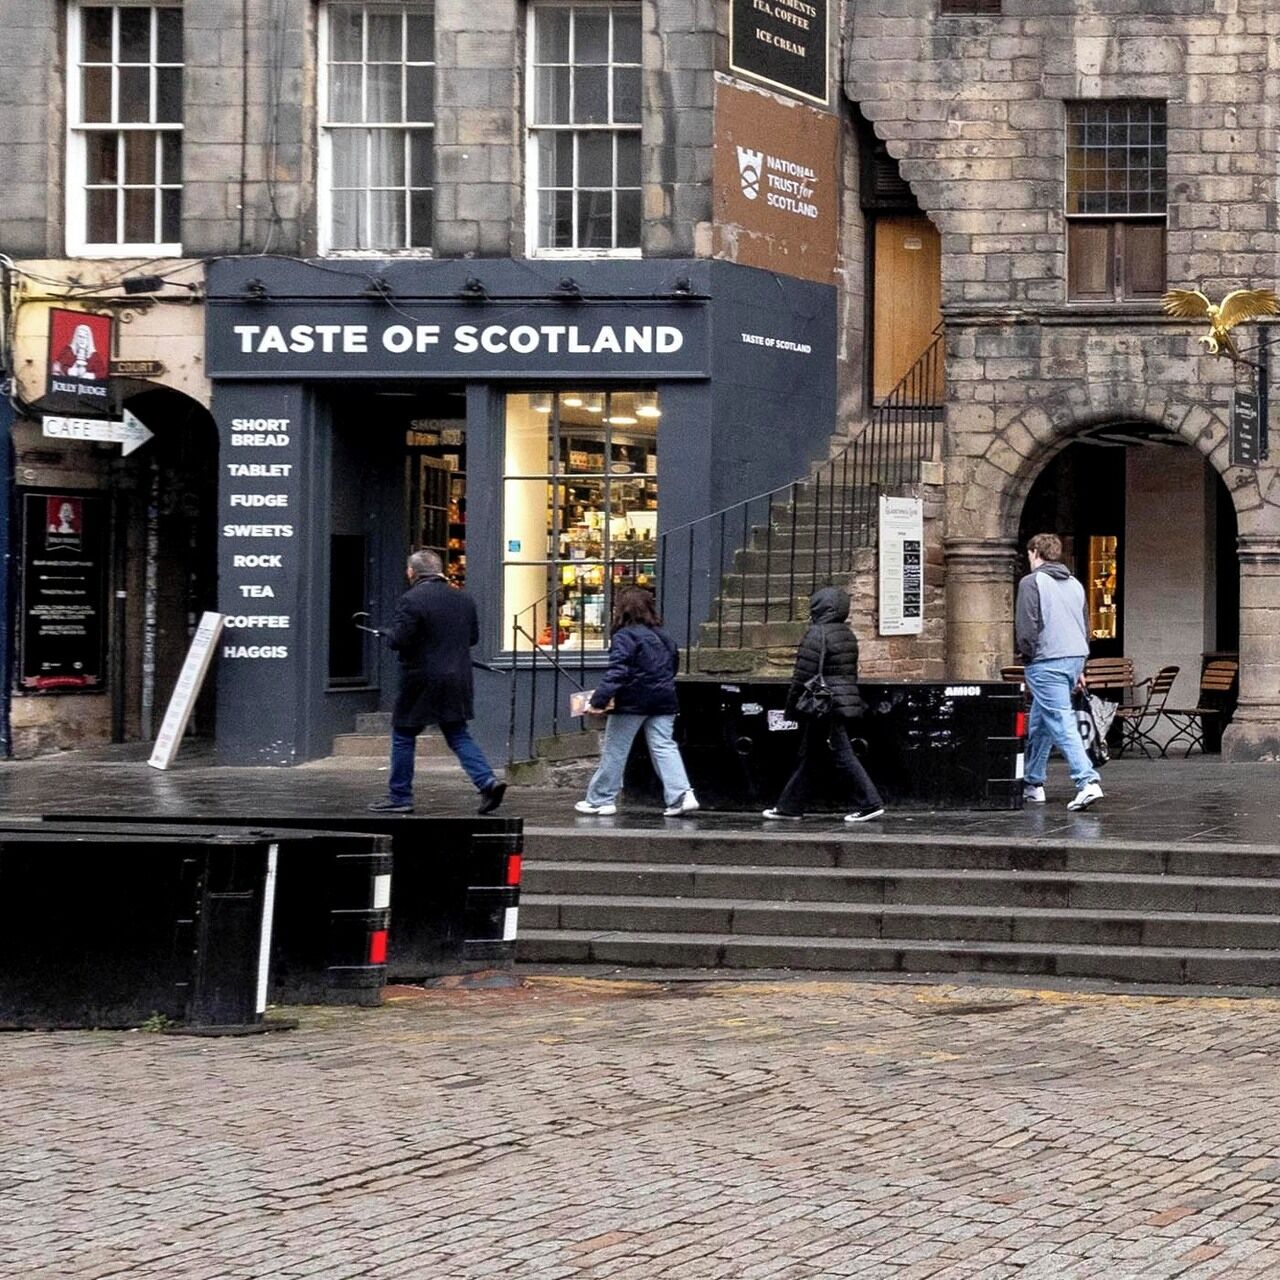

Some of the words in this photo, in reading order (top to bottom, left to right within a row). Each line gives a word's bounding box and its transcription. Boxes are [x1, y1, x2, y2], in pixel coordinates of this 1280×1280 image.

[774, 6, 810, 31] COFFEE
[756, 28, 772, 43] ICE
[773, 35, 806, 58] CREAM
[767, 156, 817, 181] NATIONAL
[767, 174, 799, 194] TRUST
[796, 182, 814, 200] for
[767, 193, 818, 218] SCOTLAND
[233, 325, 368, 354] TASTE
[381, 325, 440, 354] OF
[453, 325, 684, 354] SCOTLAND
[741, 333, 764, 346] TASTE
[764, 337, 775, 347] OF
[776, 339, 812, 353] SCOTLAND
[118, 361, 154, 372] COURT
[52, 380, 77, 394] JOLLY
[77, 382, 107, 397] JUDGE
[45, 419, 91, 437] CAFE
[231, 419, 290, 432] SHORT
[231, 433, 290, 446] BREAD
[227, 464, 292, 476] TABLET
[230, 494, 288, 507] FUDGE
[223, 524, 293, 537] SWEETS
[233, 555, 282, 568] ROCK
[239, 585, 275, 598] TEA
[223, 615, 290, 628] COFFEE
[223, 646, 288, 658] HAGGIS
